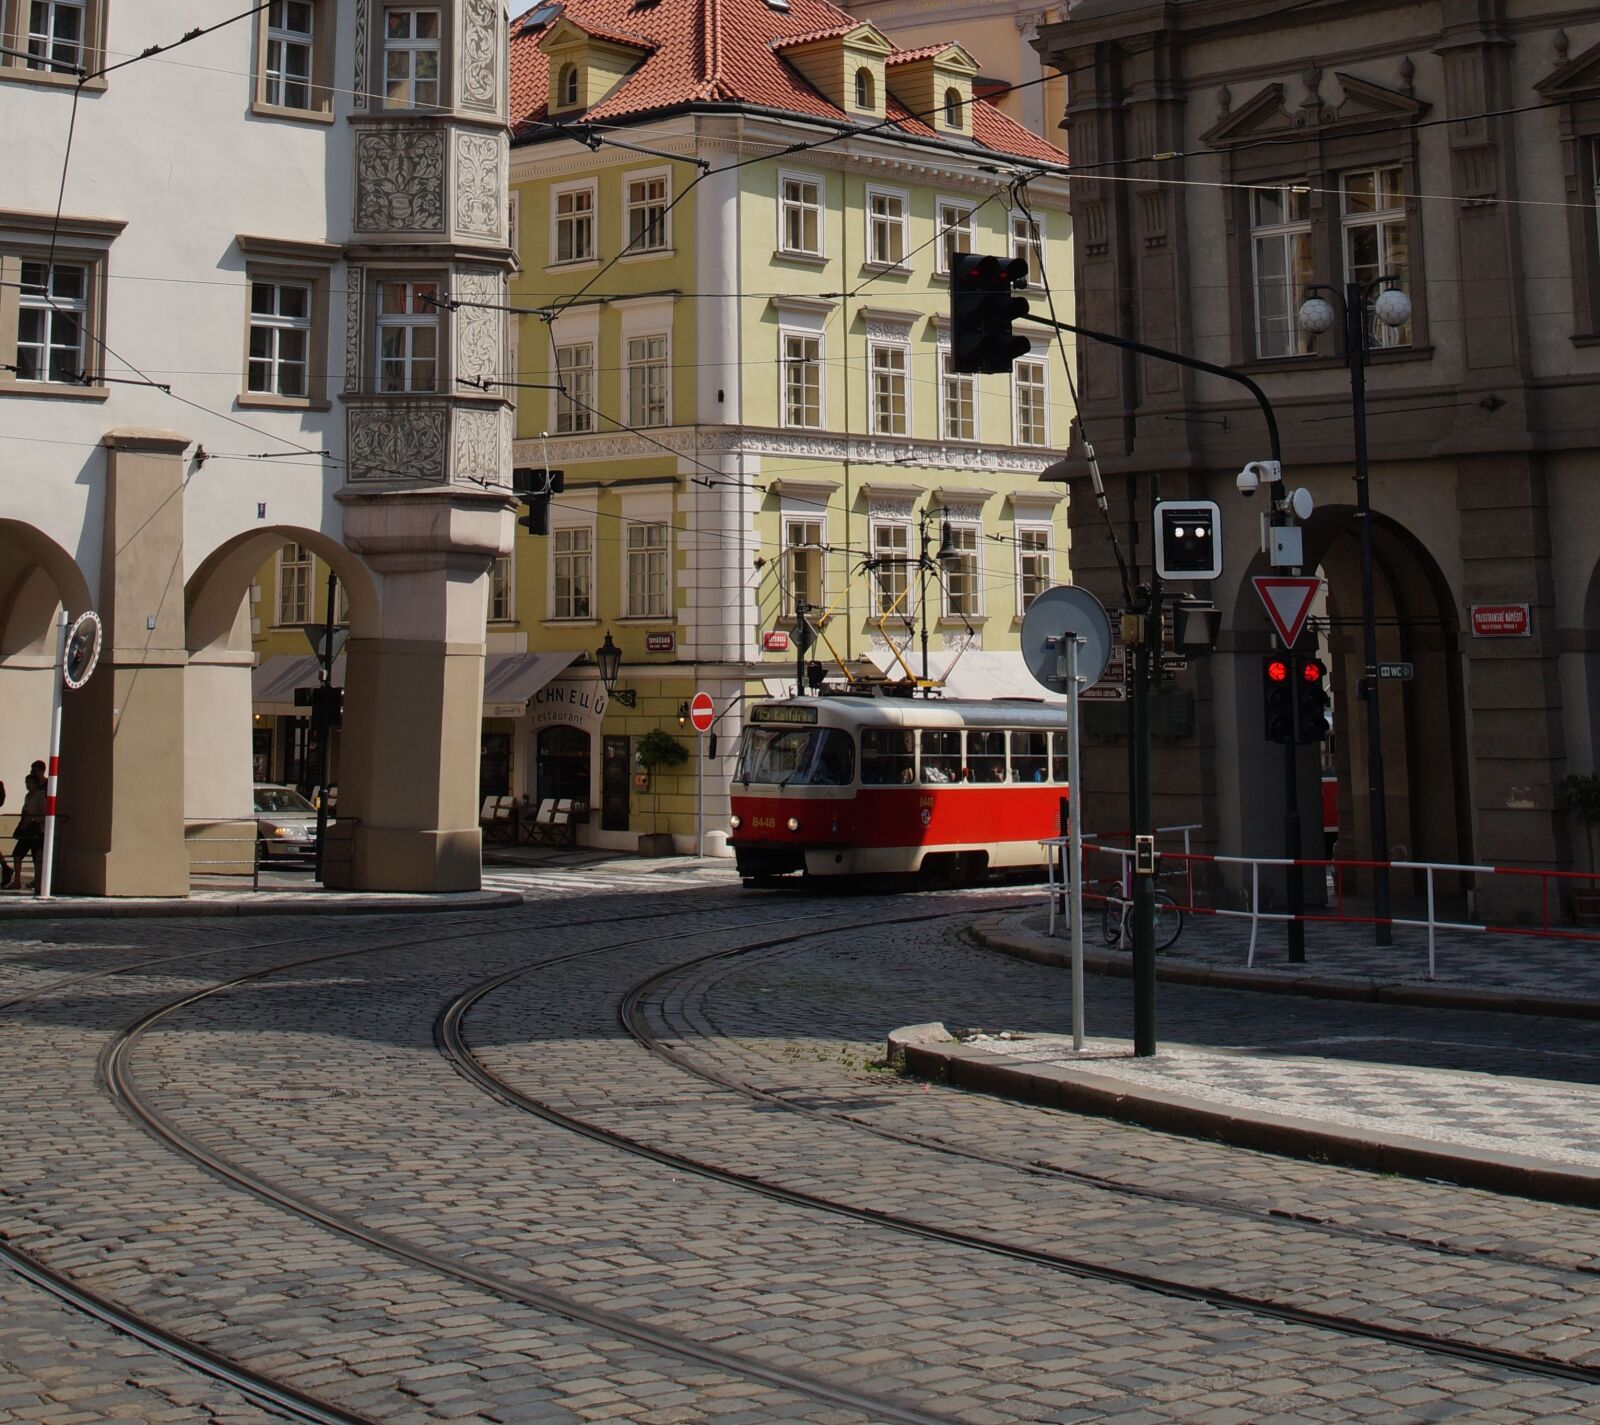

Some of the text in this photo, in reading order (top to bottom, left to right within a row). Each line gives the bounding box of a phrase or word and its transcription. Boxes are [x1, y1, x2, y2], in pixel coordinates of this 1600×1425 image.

[1390, 666, 1401, 676] WC
[529, 712, 584, 724] restaurant
[752, 816, 776, 828] 8448
